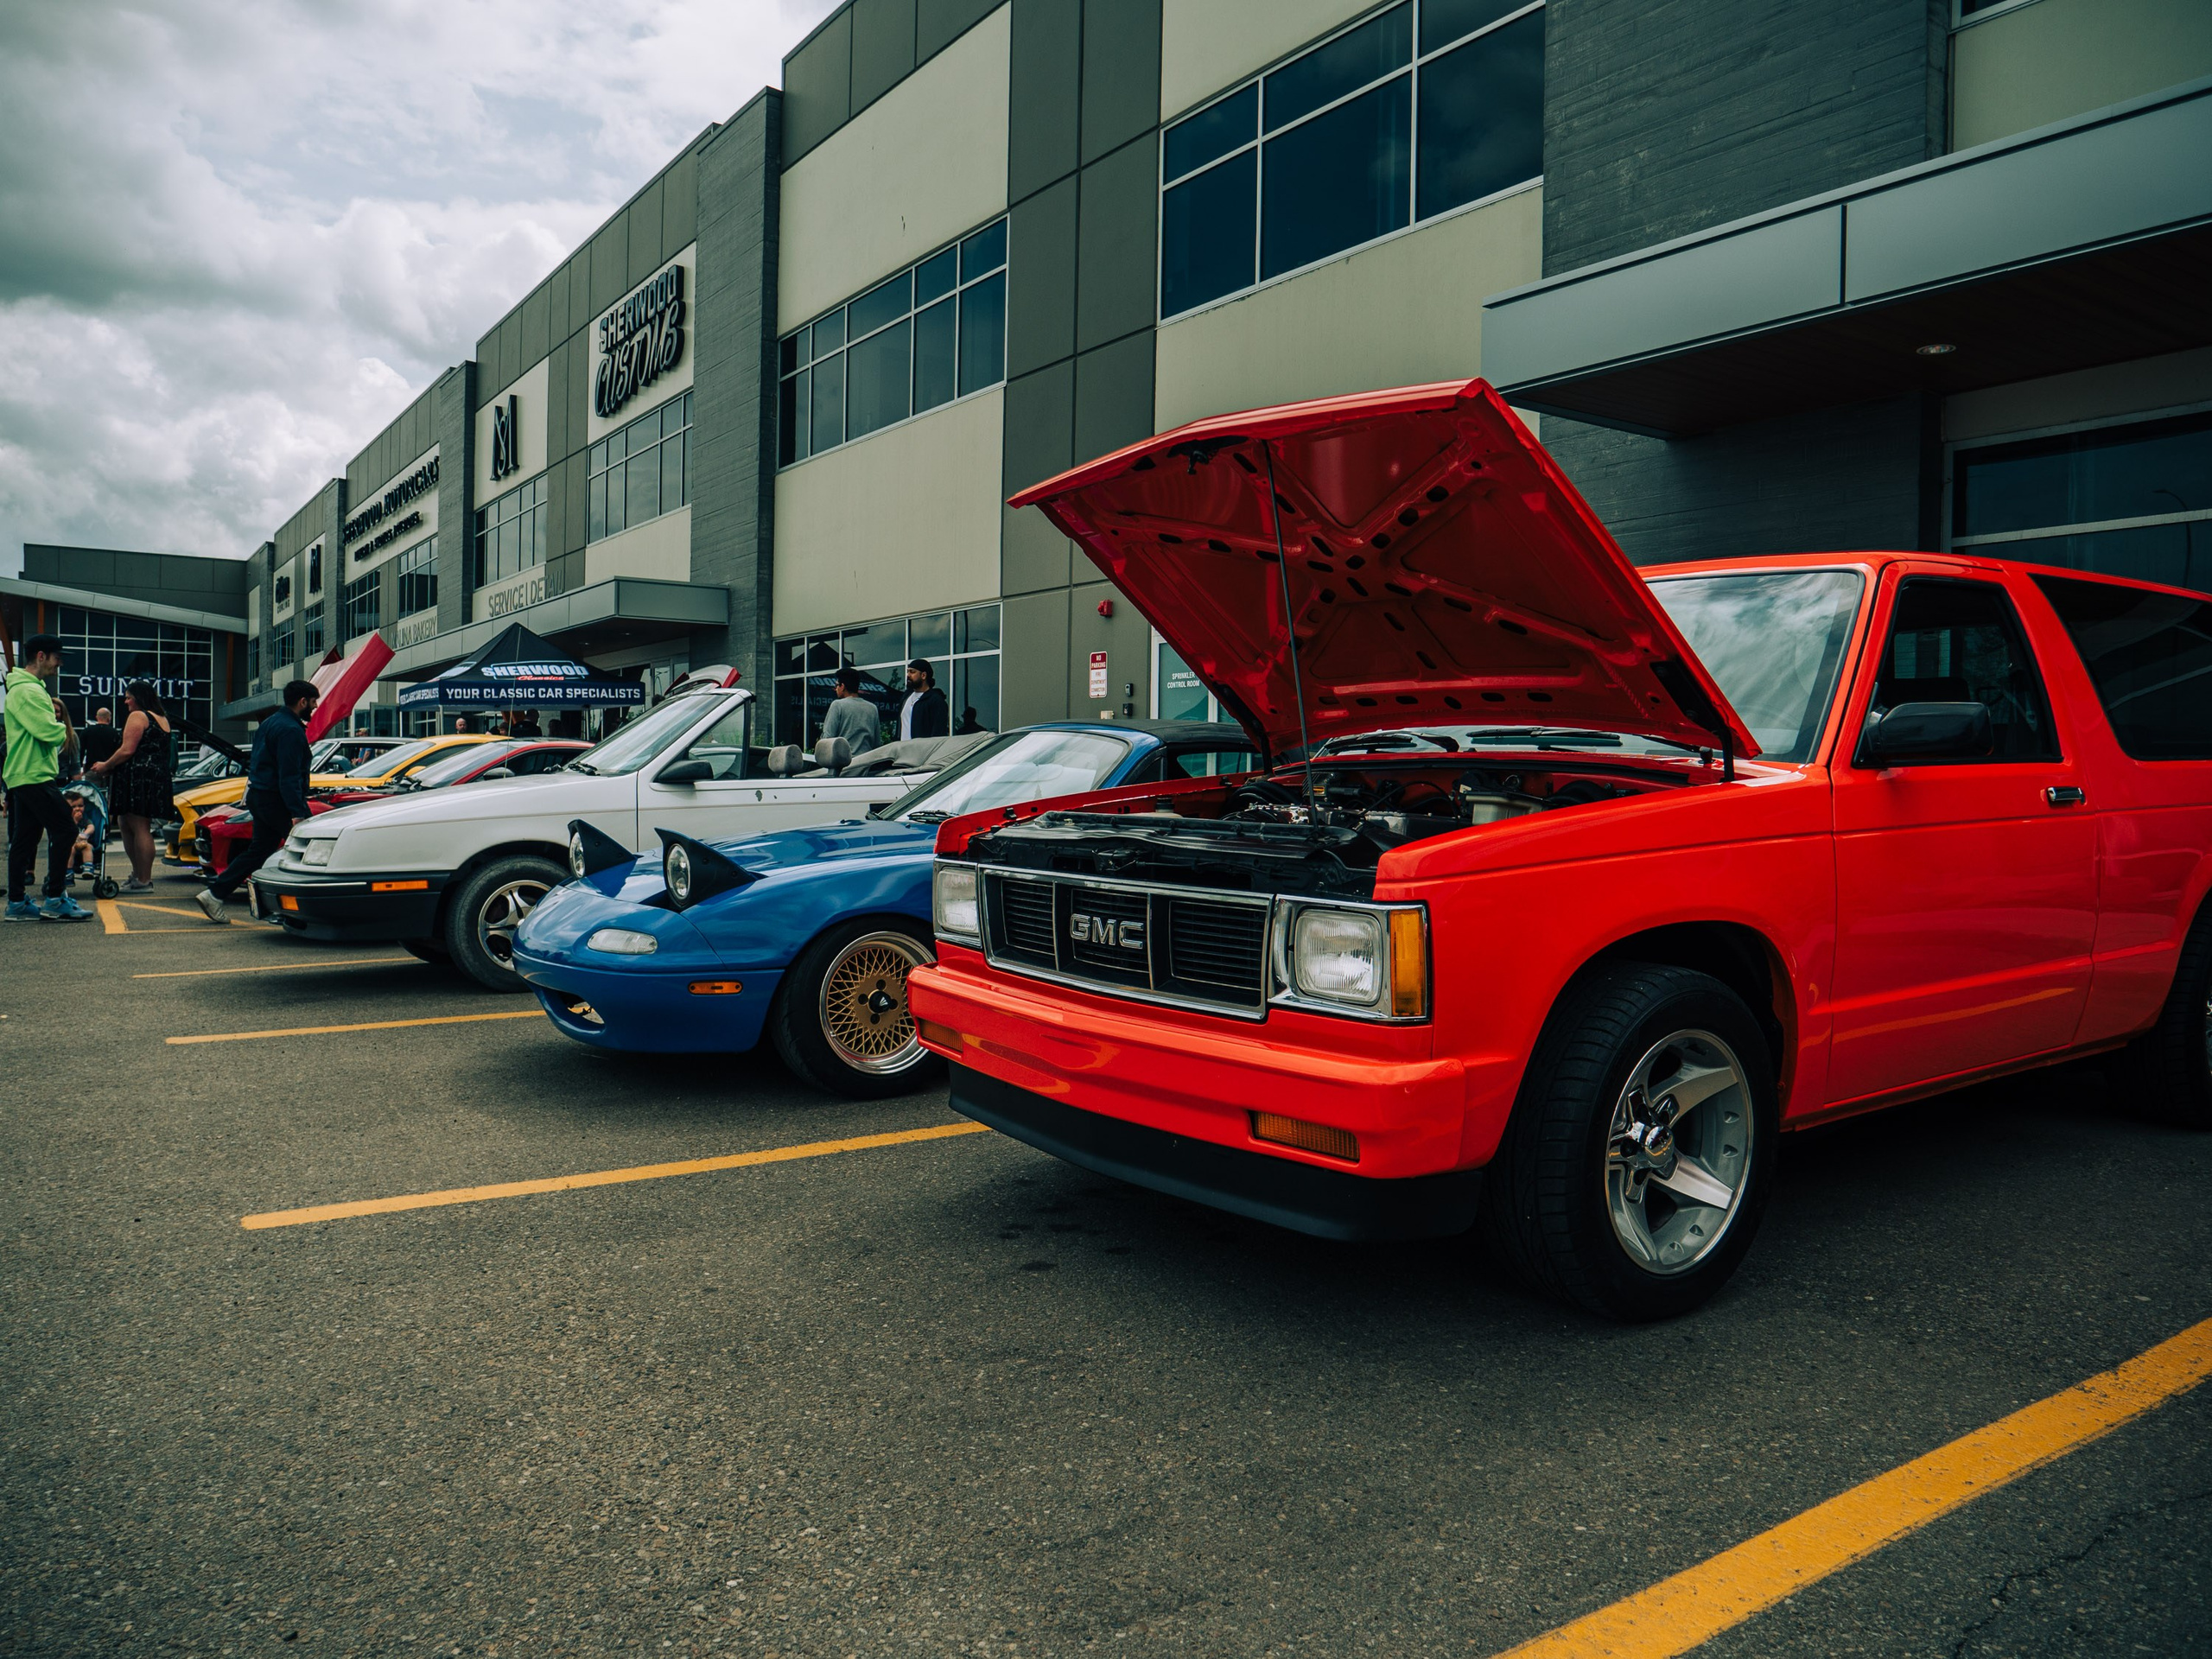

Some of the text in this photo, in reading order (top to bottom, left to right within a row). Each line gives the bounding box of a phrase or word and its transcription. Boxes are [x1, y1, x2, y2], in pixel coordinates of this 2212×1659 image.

[598, 264, 684, 353] SHERWOOD
[594, 300, 686, 417] CUSTOMS
[489, 580, 524, 617] SERVICE
[413, 615, 436, 643] BAKERY
[481, 664, 589, 677] SHERWOOD
[446, 688, 640, 699] YOUR CLASSIC CAR SPECIALISTS
[1070, 913, 1144, 950] GMC
